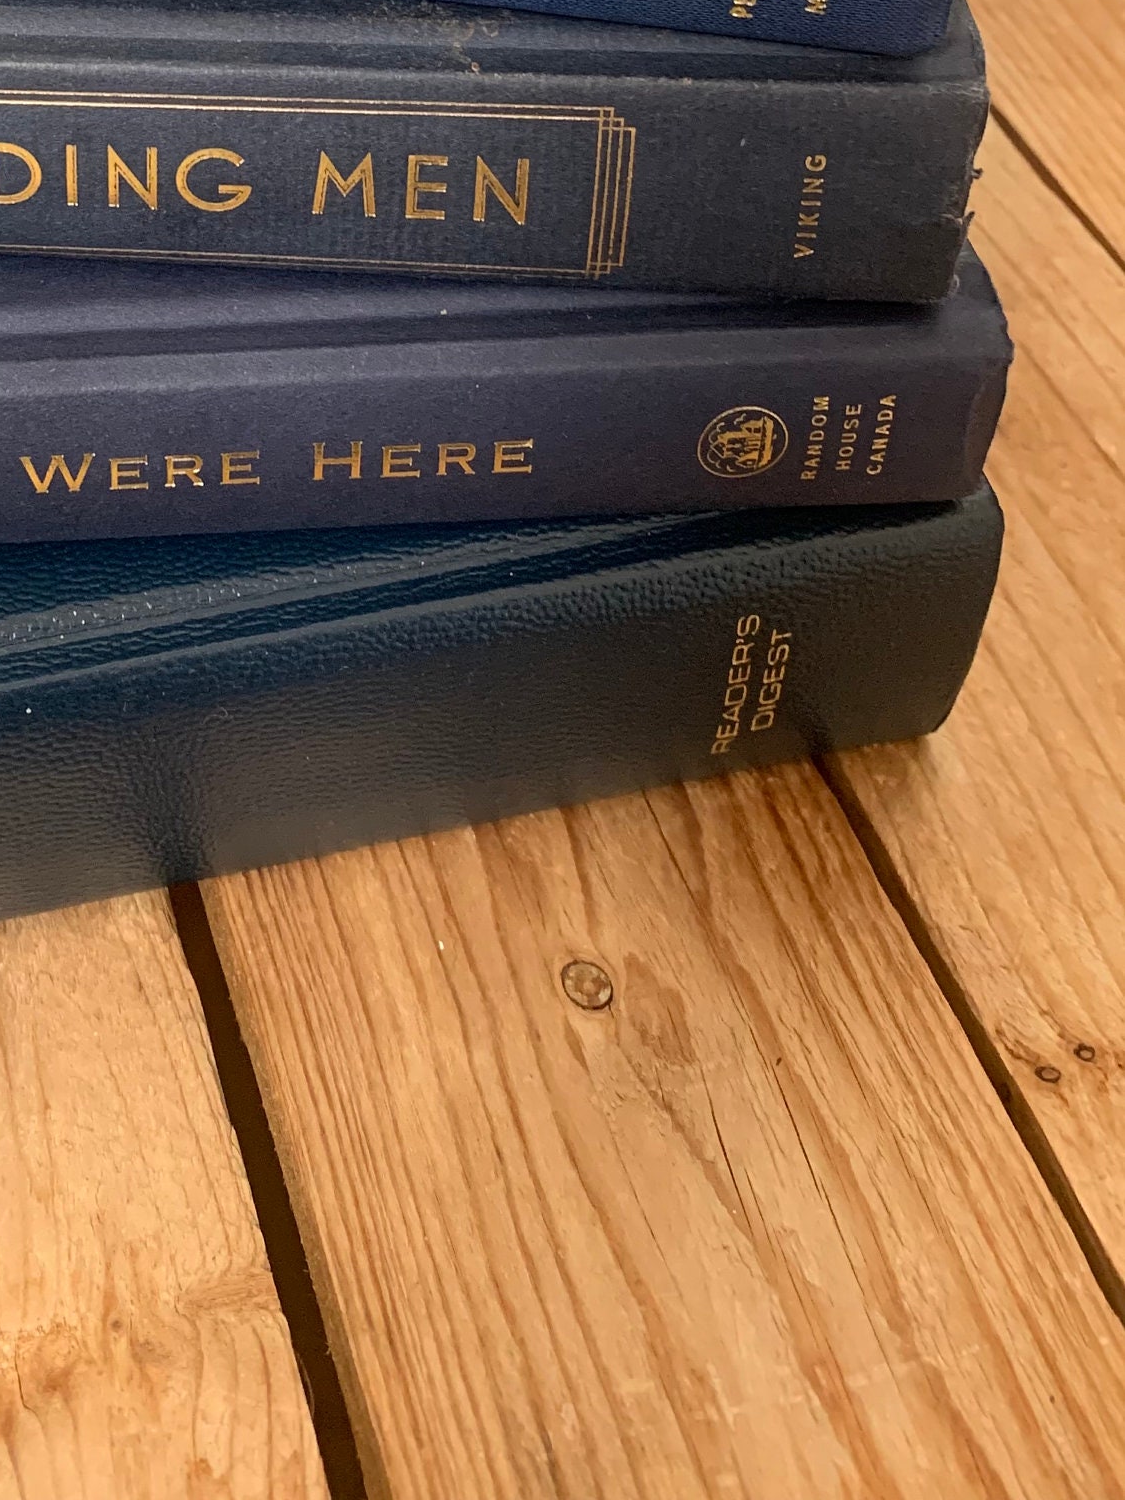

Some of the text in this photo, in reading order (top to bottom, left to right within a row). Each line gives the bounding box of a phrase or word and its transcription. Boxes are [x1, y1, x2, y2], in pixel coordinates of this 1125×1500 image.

[311, 149, 531, 227] MEN
[792, 152, 828, 260] VIKING
[17, 449, 261, 495] WERE
[311, 437, 536, 481] HERE
[799, 394, 831, 482] RANDOM
[834, 402, 863, 472] HOUSE
[865, 393, 898, 476] CANADA
[710, 613, 761, 755] READER'S
[749, 628, 793, 732] DIGEST
